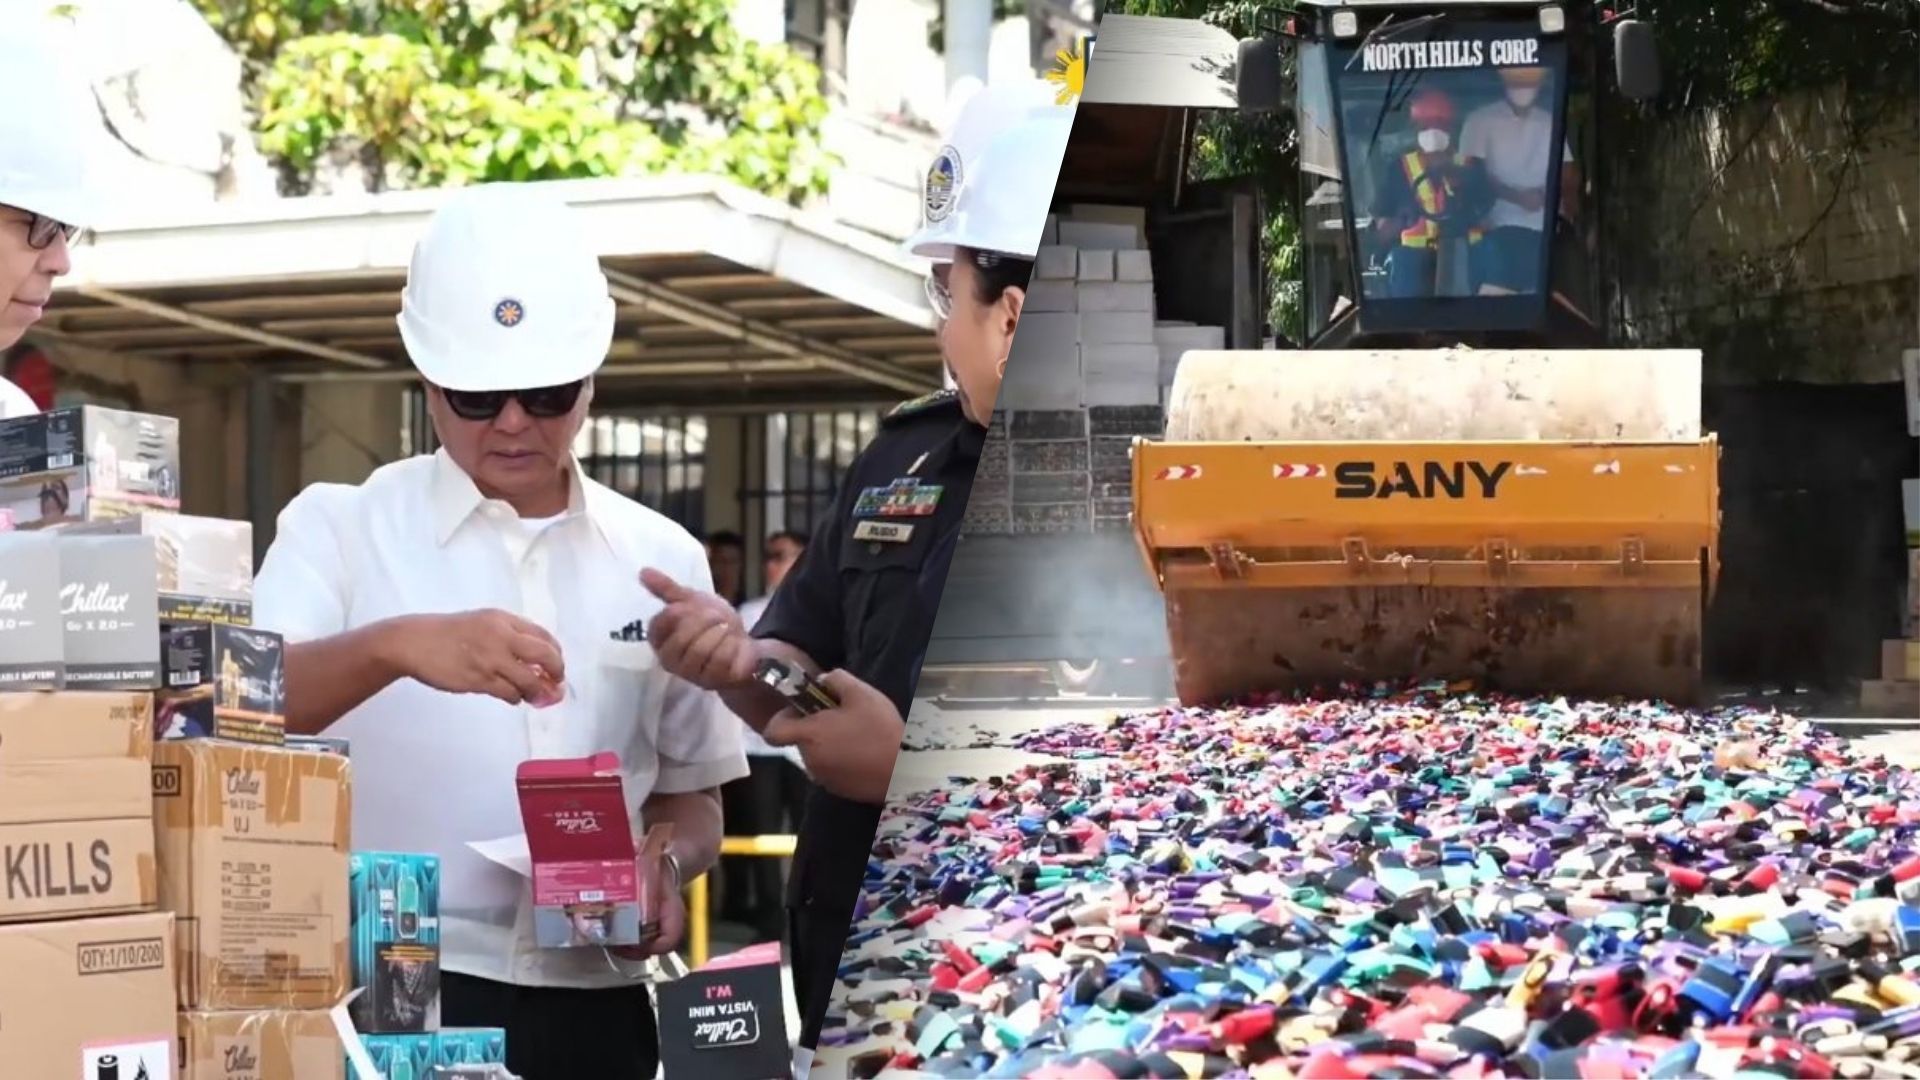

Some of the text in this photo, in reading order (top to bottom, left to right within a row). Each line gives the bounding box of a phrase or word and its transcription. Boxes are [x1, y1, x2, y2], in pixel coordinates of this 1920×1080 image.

[1490, 38, 1539, 66] CORP.
[1335, 461, 1513, 499] SANY
[59, 581, 130, 615] Chillax
[122, 670, 155, 681] BATTERY
[5, 839, 113, 900] KILLS
[81, 943, 162, 969] QTY:1/10/200
[688, 1000, 755, 1019] VISTA MINI
[694, 1018, 749, 1043] Chillax
